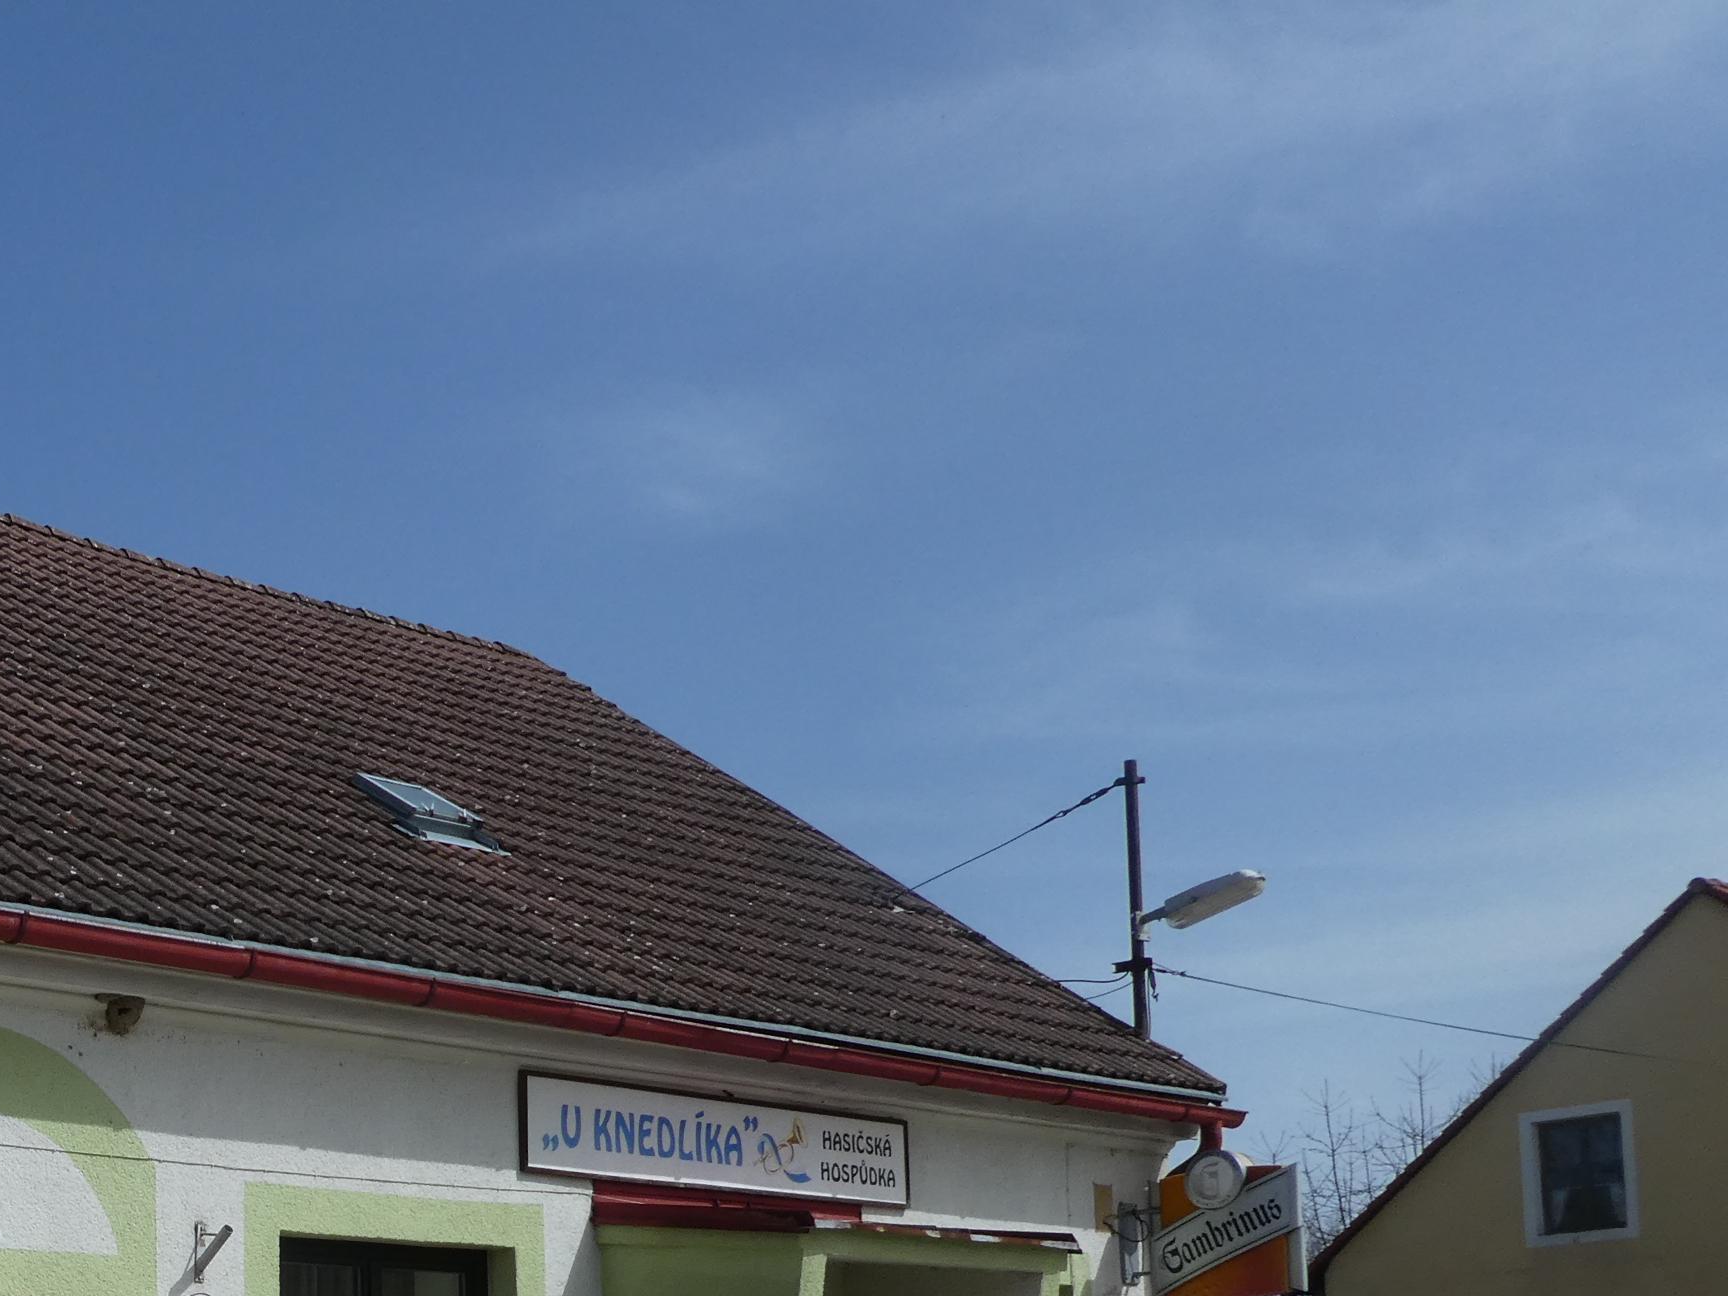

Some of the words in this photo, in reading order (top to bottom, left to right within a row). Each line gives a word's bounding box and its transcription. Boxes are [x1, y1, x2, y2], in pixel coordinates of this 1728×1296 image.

[821, 1129, 893, 1158] HASIČSKÁ
[820, 1159, 896, 1188] HOSPŮDKA
[1161, 1197, 1283, 1274] Gambrinus
